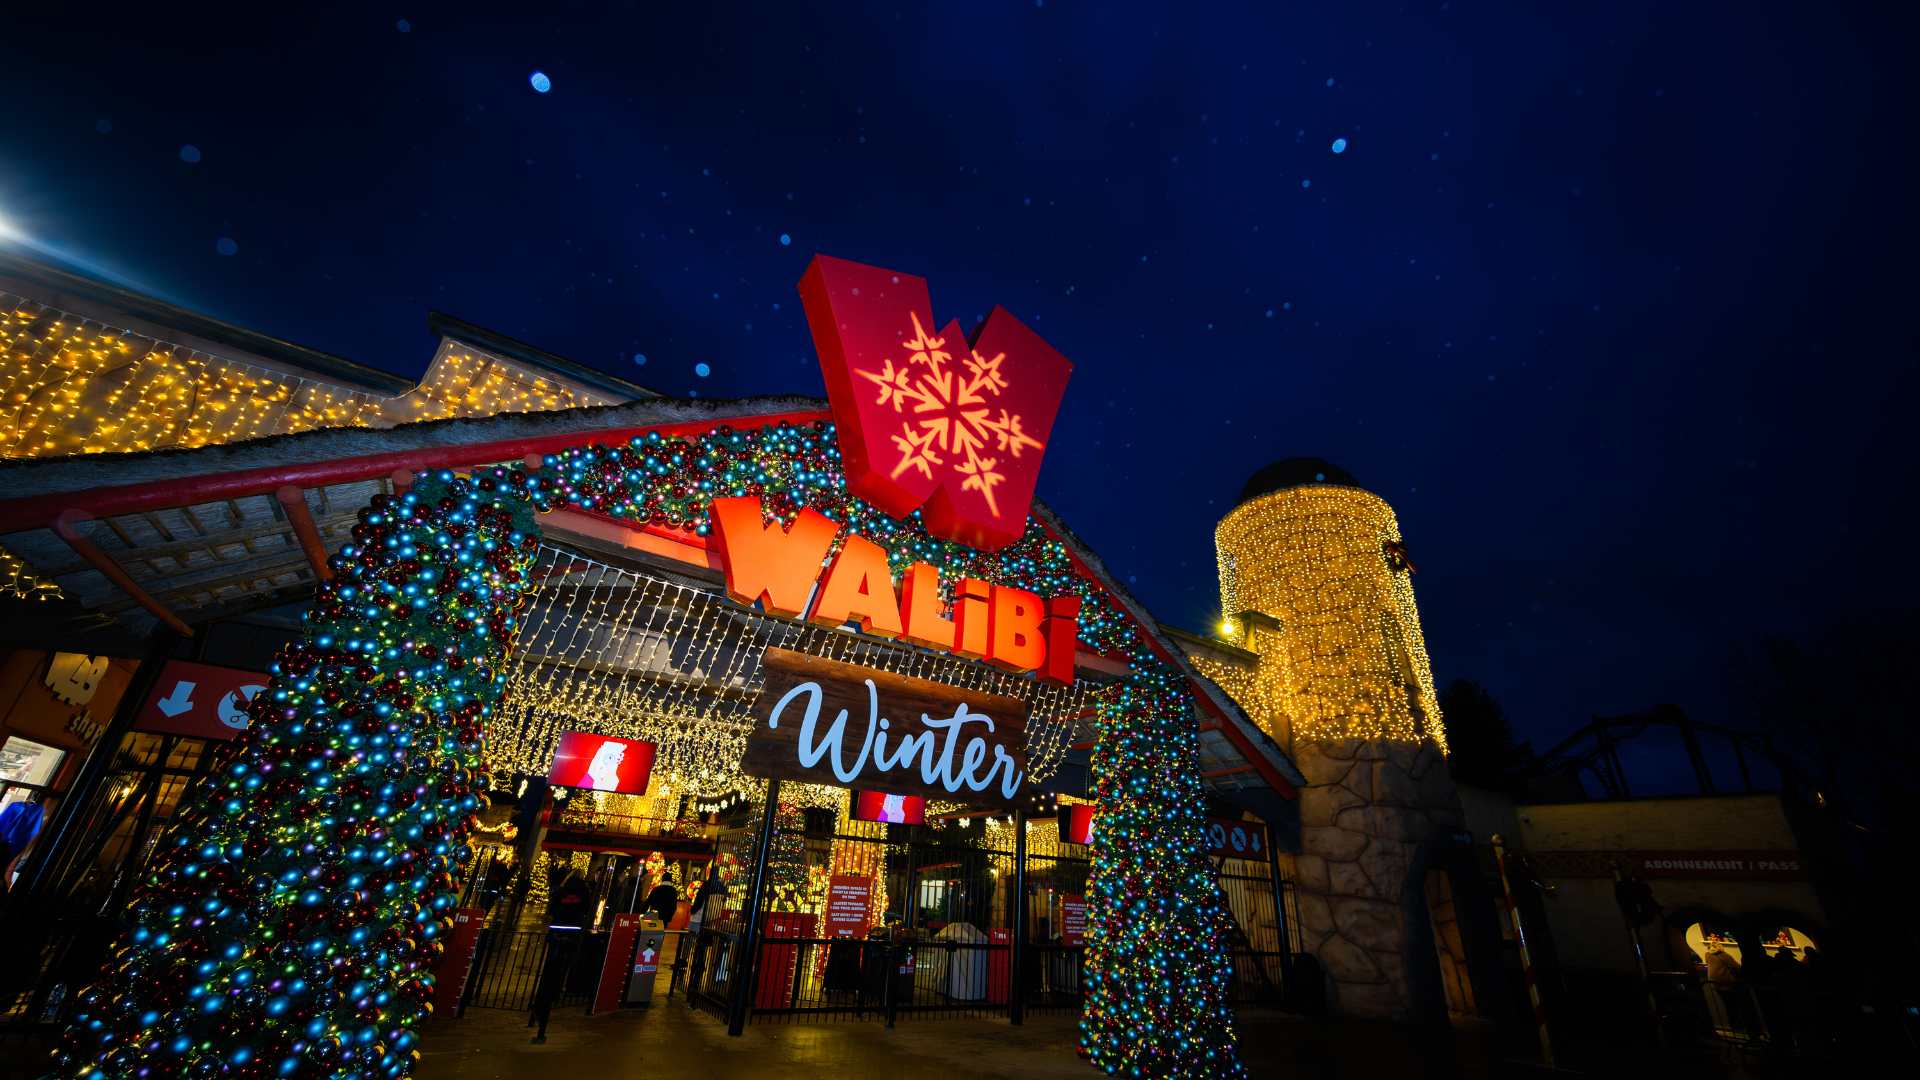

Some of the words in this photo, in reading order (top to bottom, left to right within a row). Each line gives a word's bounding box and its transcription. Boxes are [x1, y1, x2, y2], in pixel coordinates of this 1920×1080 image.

[769, 680, 1023, 799] Winter
[1644, 859, 1744, 870] ABONNEMENT
[1758, 860, 1800, 871] PASS
